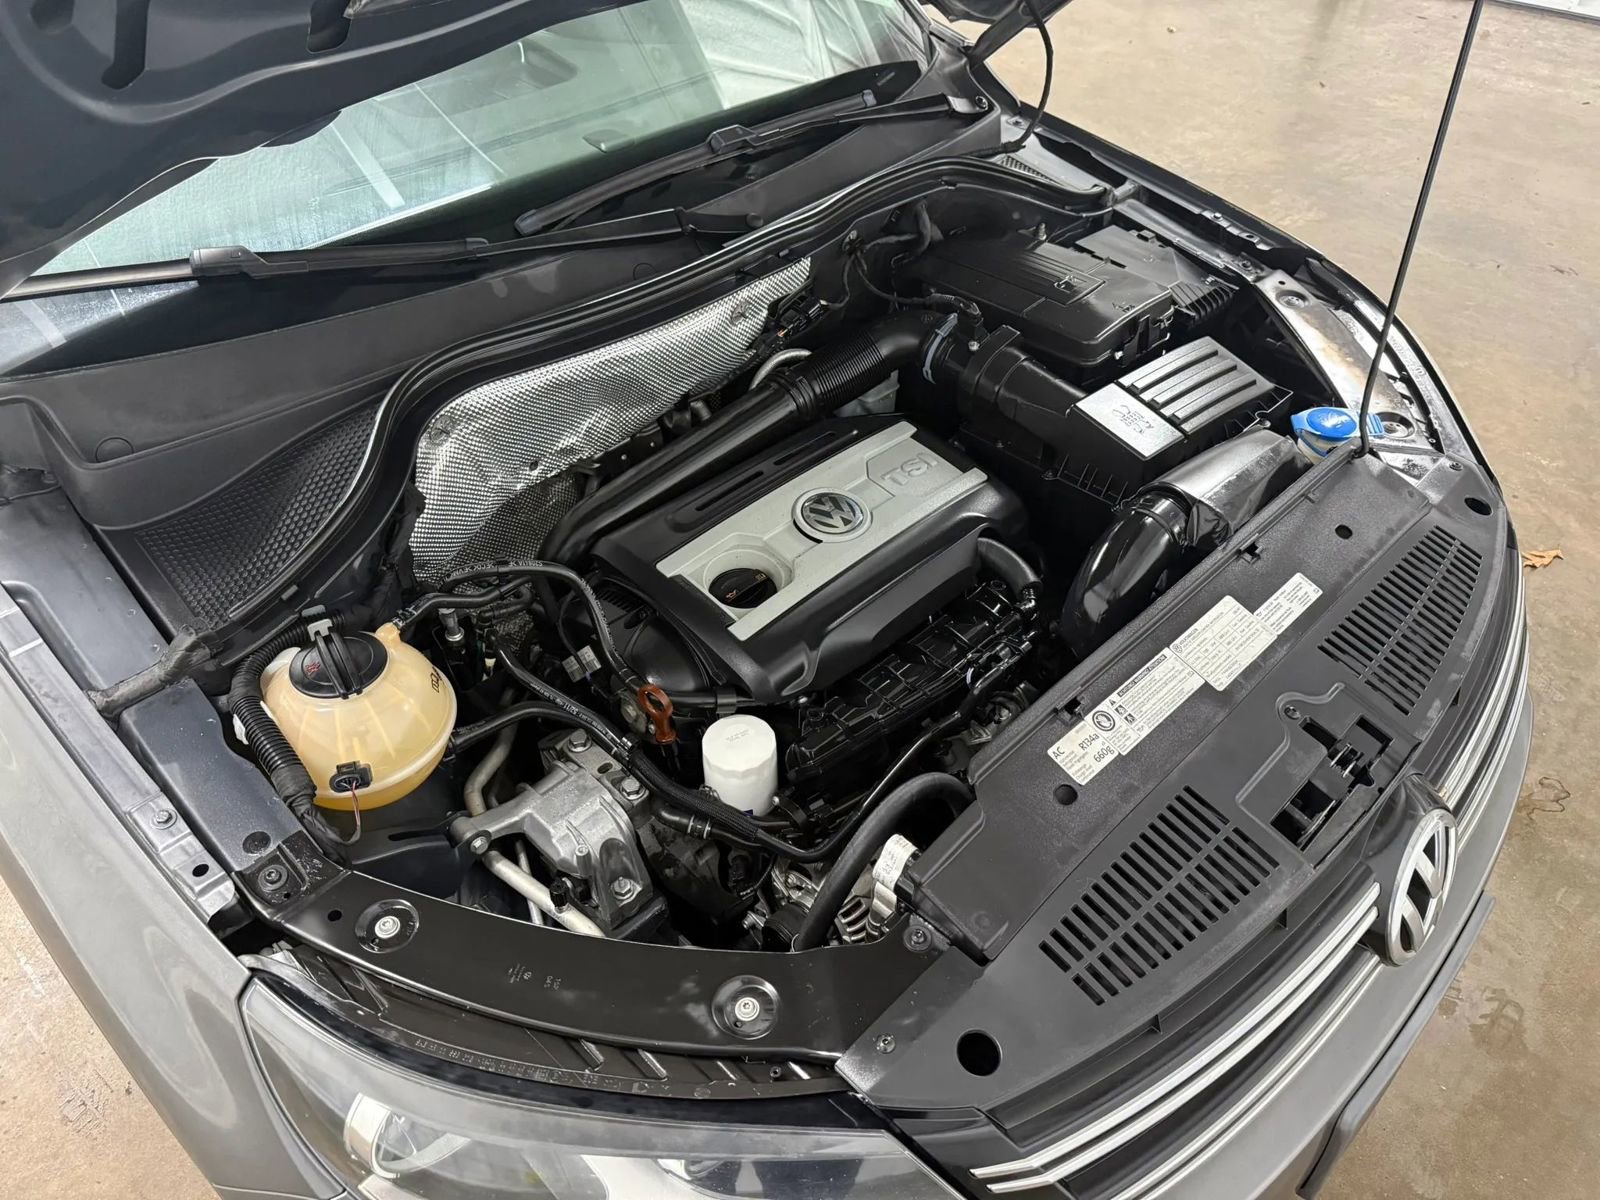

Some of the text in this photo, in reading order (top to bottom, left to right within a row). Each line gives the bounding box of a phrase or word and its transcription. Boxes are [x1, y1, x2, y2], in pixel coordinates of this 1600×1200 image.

[881, 453, 939, 485] TSI
[1078, 732, 1100, 751] R134a
[1051, 746, 1066, 760] AC
[1093, 744, 1115, 763] 660g
